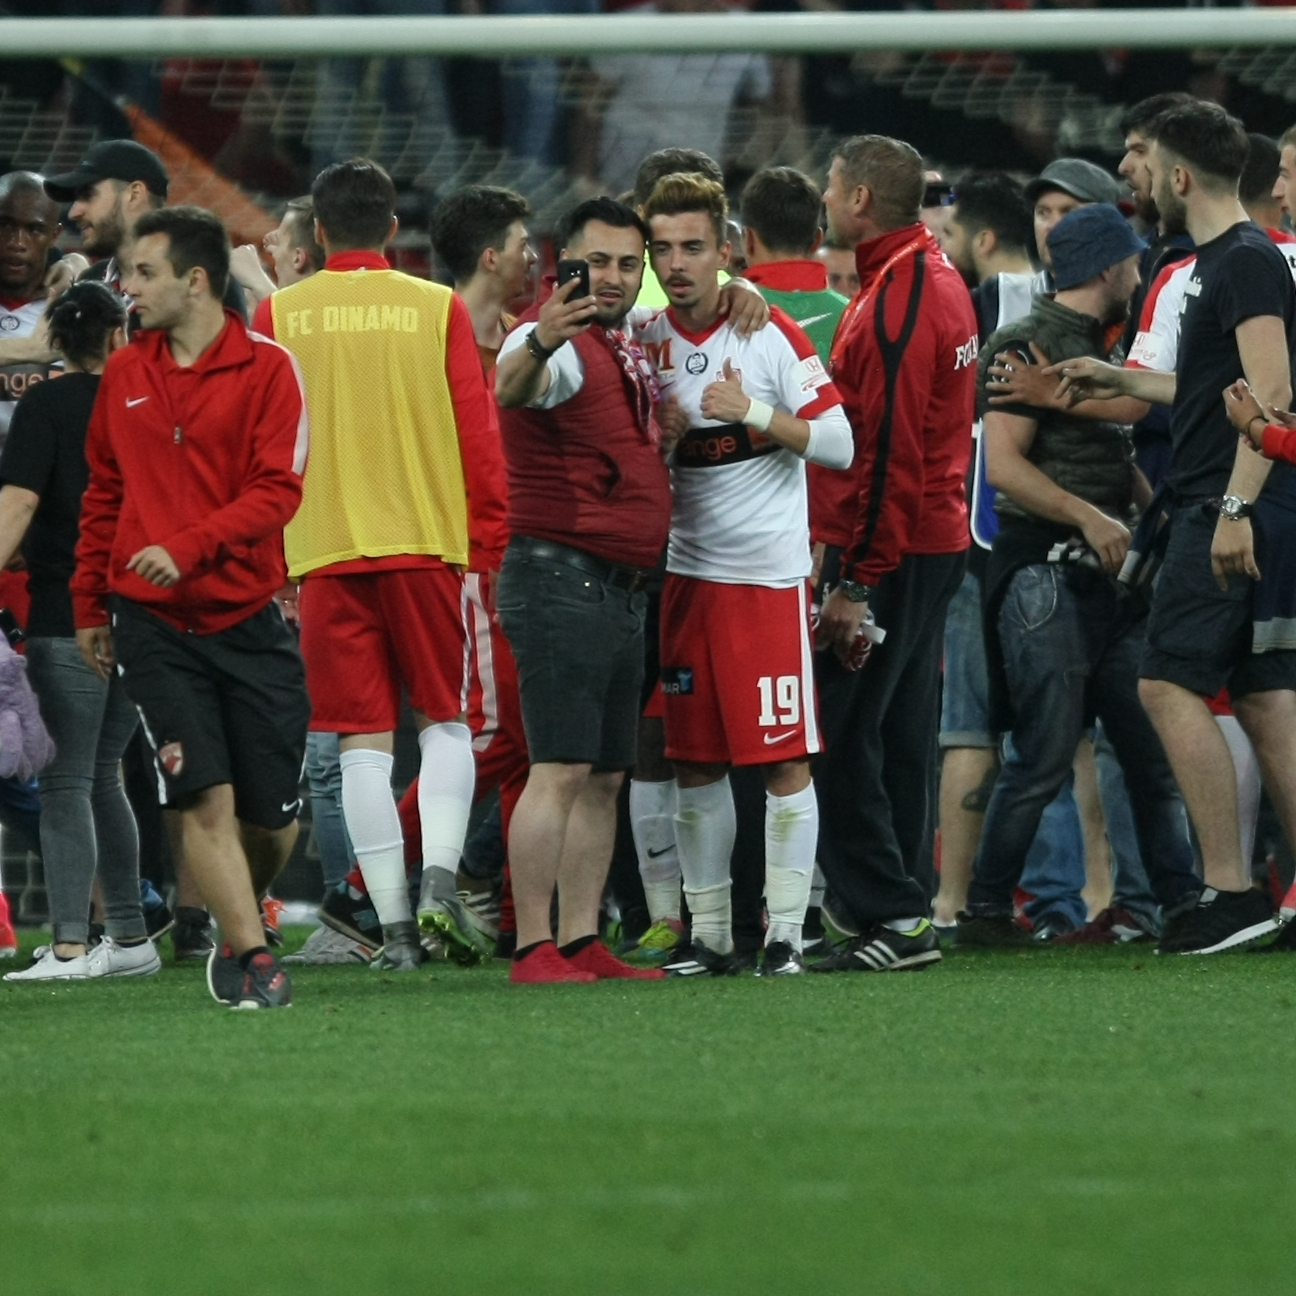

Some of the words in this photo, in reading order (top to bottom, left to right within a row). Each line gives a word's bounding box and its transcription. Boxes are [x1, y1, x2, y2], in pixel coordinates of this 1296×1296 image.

[286, 309, 312, 339] FC
[322, 305, 419, 333] DINAMO
[757, 675, 800, 726] 19
